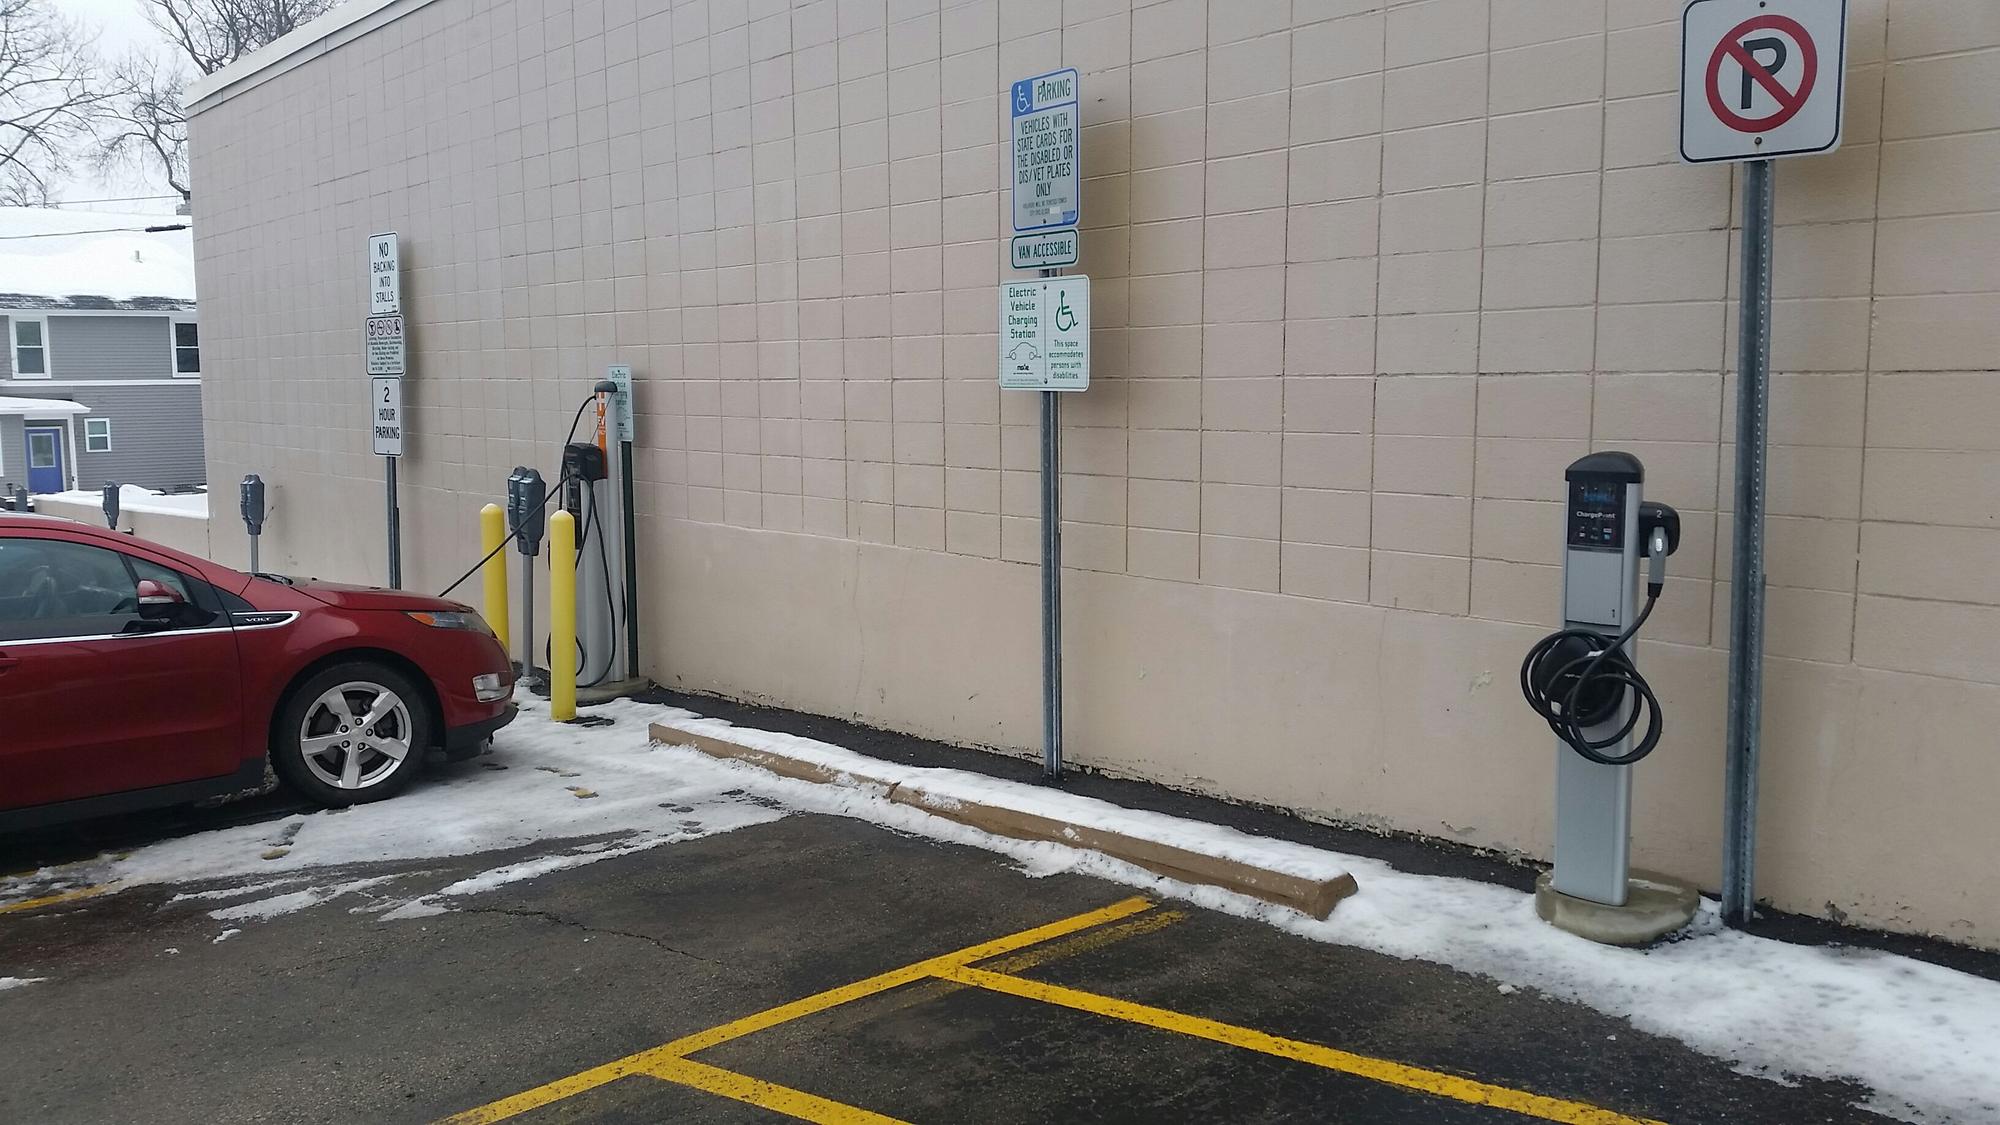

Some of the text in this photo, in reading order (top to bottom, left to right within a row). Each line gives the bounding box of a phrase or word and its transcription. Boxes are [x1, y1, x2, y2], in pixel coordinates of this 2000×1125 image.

[1038, 79, 1071, 102] PARKING
[1021, 112, 1068, 135] VEHICLES WITH
[1017, 128, 1073, 152] STATE CARDS FOR
[1017, 145, 1073, 168] THE DISABLED OR
[1047, 162, 1071, 179] PLATES
[1036, 182, 1051, 197] ONLY
[379, 242, 388, 258] NO
[1018, 240, 1072, 259] VAN ACCESSIBLE
[373, 260, 395, 273] BACKING
[379, 276, 390, 287] INTO
[376, 291, 394, 303] STALLS
[1009, 287, 1037, 298] Electric
[1010, 300, 1036, 311] Vehicle
[1008, 315, 1038, 327] Charging
[1010, 329, 1036, 339] Station
[1054, 339, 1078, 350] This space
[384, 387, 390, 402] 2
[379, 408, 395, 421] HOUR
[375, 426, 400, 439] PARKING
[1656, 509, 1662, 518] 2
